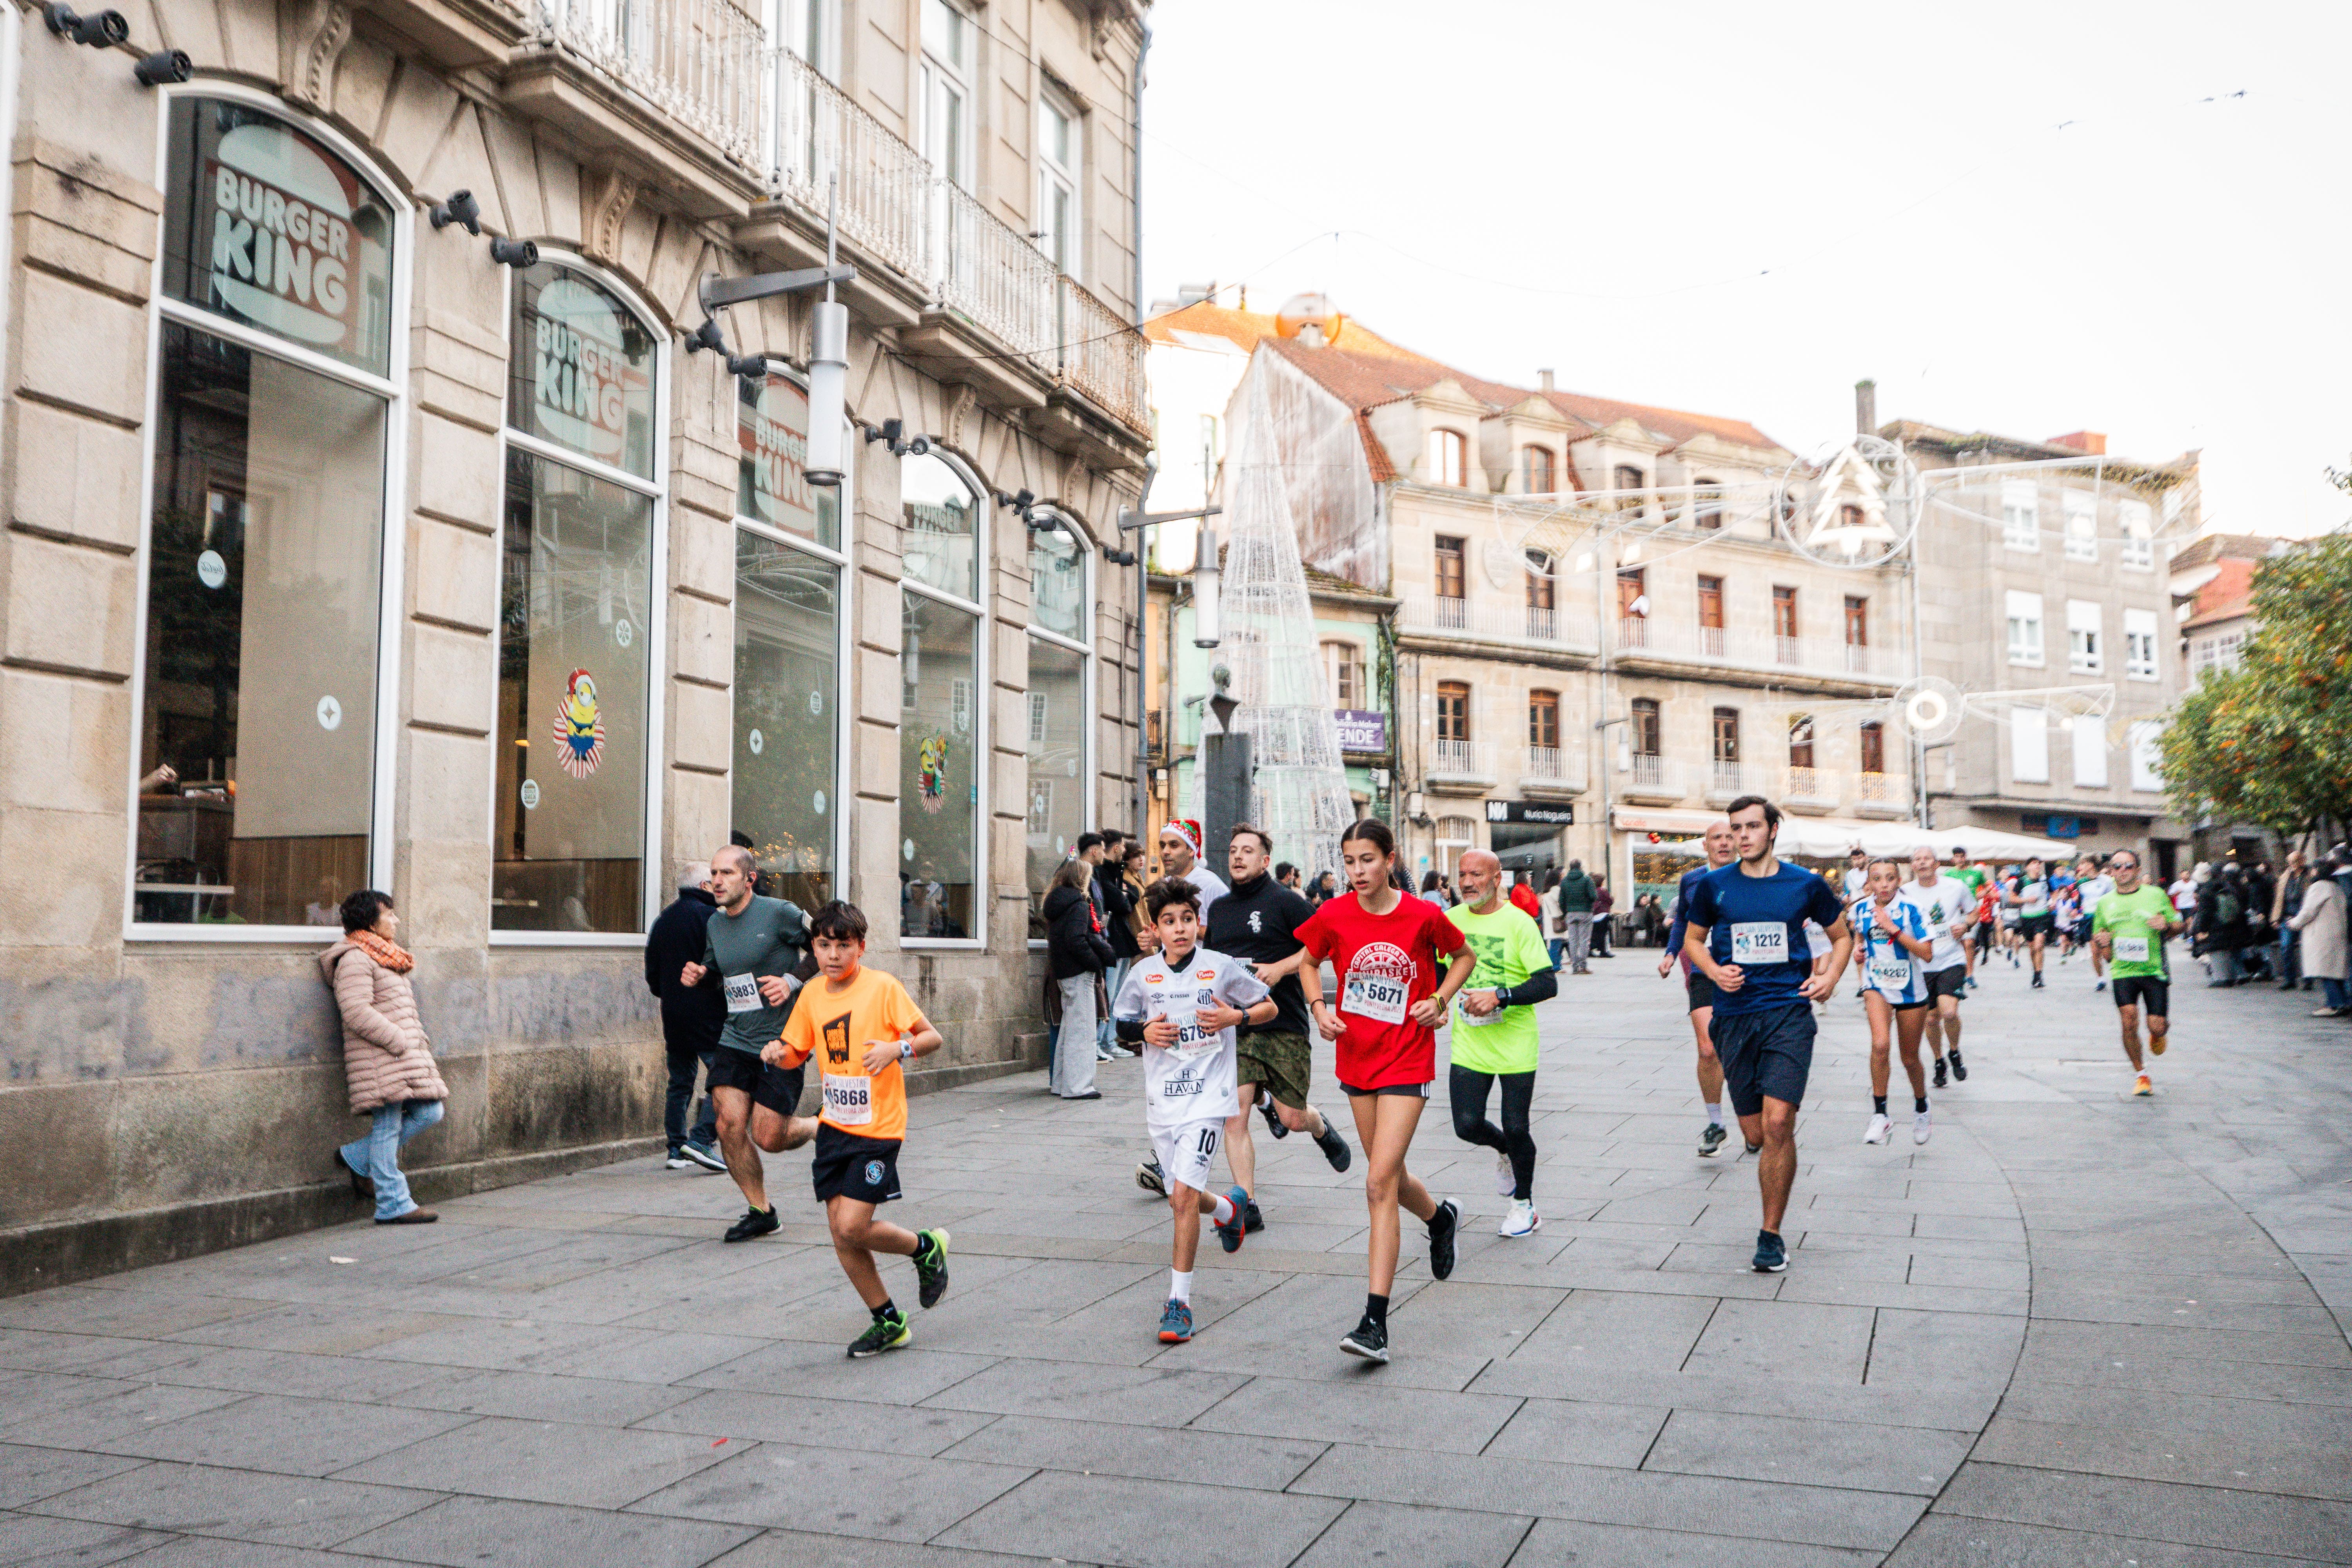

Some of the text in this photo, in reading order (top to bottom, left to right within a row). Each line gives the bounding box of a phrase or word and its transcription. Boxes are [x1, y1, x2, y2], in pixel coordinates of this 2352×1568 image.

[216, 167, 348, 262] BURGER
[214, 209, 347, 315] KING
[536, 317, 624, 386] BURGER
[535, 352, 623, 430] KING
[755, 416, 806, 466] BURGE
[1338, 728, 1374, 744] ENDE
[1755, 933, 1781, 947] 1212
[1354, 947, 1373, 968] CAPITAL
[1374, 945, 1400, 957] GALEGA
[1362, 973, 1374, 981] SAN
[1376, 976, 1405, 989] SILVESTRE
[731, 983, 755, 998] 5883
[1368, 983, 1403, 1004] 5871
[1364, 1000, 1402, 1013] PONTEVEDRA 2025
[1181, 1040, 1207, 1051] PONTEVEDRA
[1182, 1070, 1190, 1078] H
[838, 1078, 867, 1088] SILVESTRE
[1165, 1081, 1203, 1094] HAVAN
[833, 1088, 867, 1105] 5868
[1198, 1127, 1216, 1155] 10
